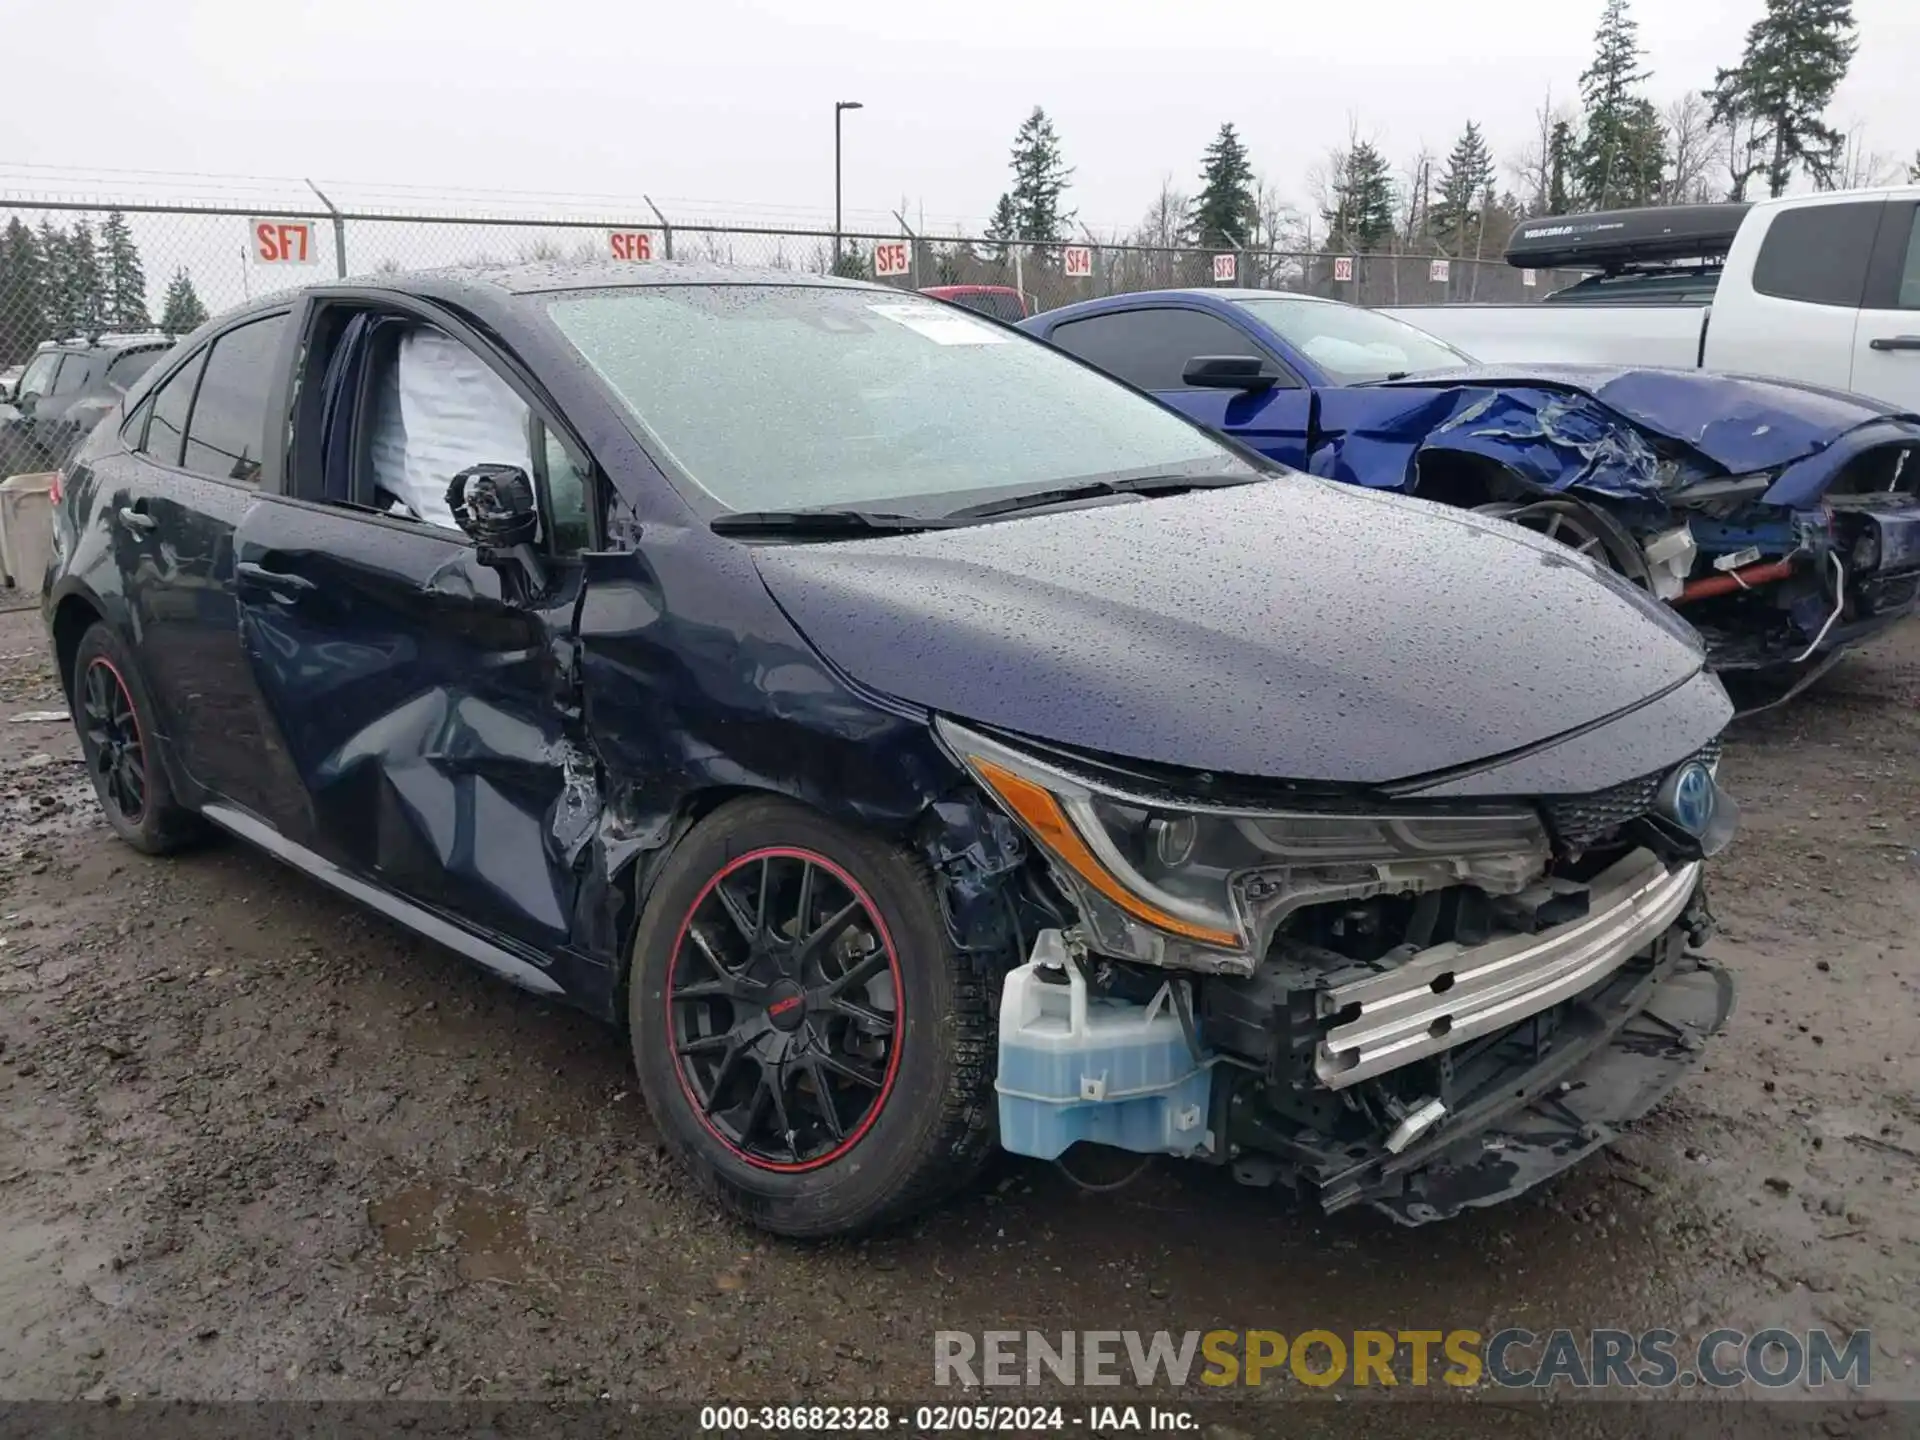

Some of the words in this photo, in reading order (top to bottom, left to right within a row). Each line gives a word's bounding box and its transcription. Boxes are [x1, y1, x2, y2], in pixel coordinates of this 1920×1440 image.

[257, 223, 307, 261] SF7
[611, 233, 650, 260] SF6
[877, 244, 905, 271] SF5
[1067, 249, 1089, 273] SF4
[1215, 257, 1233, 278] SF3
[1336, 260, 1350, 278] SF2
